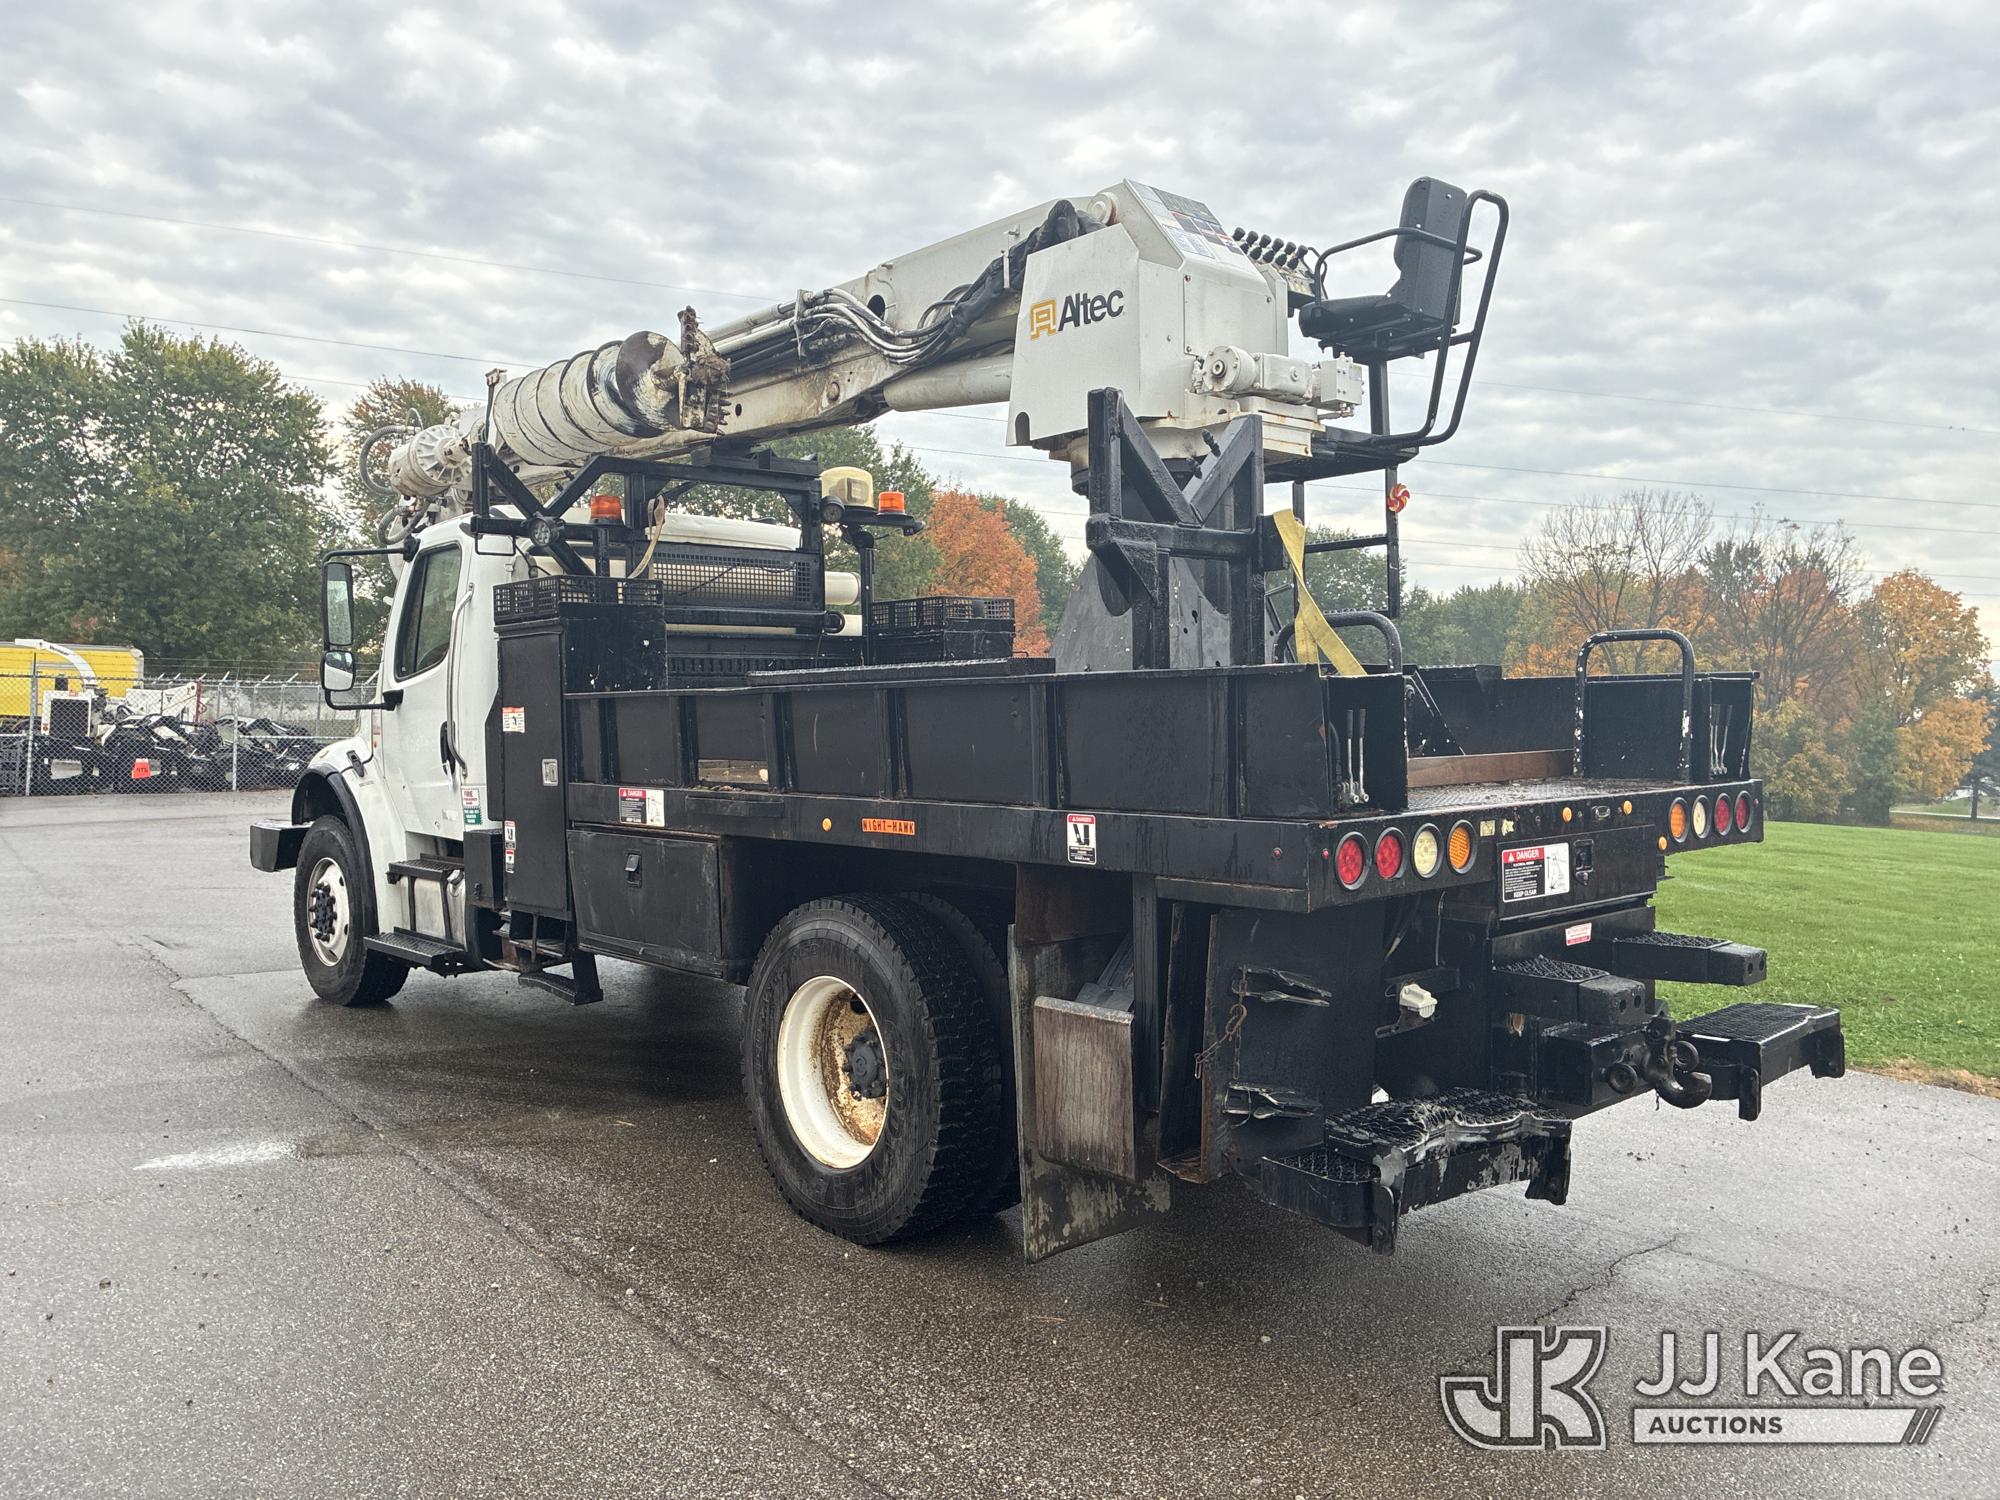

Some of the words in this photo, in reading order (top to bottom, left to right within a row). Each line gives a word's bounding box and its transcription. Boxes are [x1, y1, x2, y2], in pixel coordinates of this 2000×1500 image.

[1057, 289, 1124, 332] Altec
[862, 819, 915, 834] NIGHT-HAWK
[1516, 848, 1540, 860] DANGER
